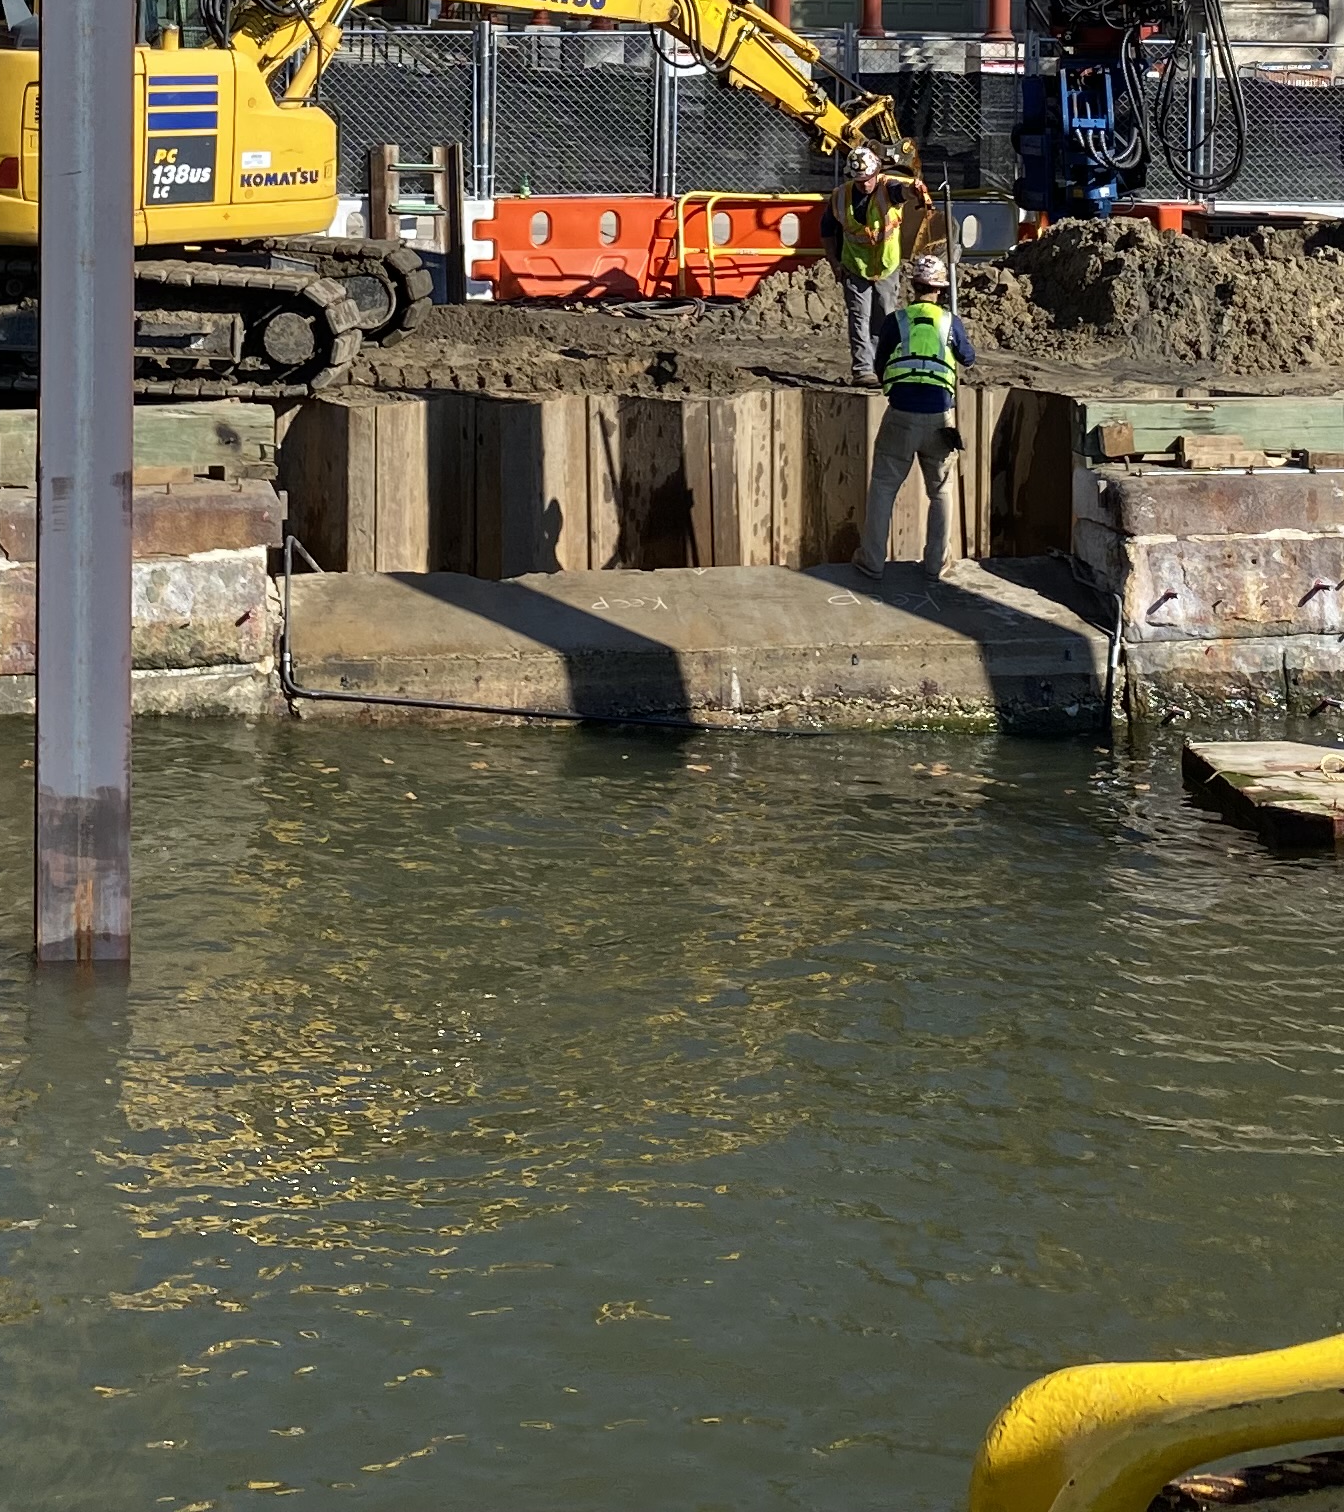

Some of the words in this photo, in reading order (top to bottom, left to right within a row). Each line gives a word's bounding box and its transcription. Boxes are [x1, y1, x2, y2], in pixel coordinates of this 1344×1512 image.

[154, 148, 178, 164] PC
[240, 167, 319, 188] KOMATSU
[152, 186, 170, 198] LC
